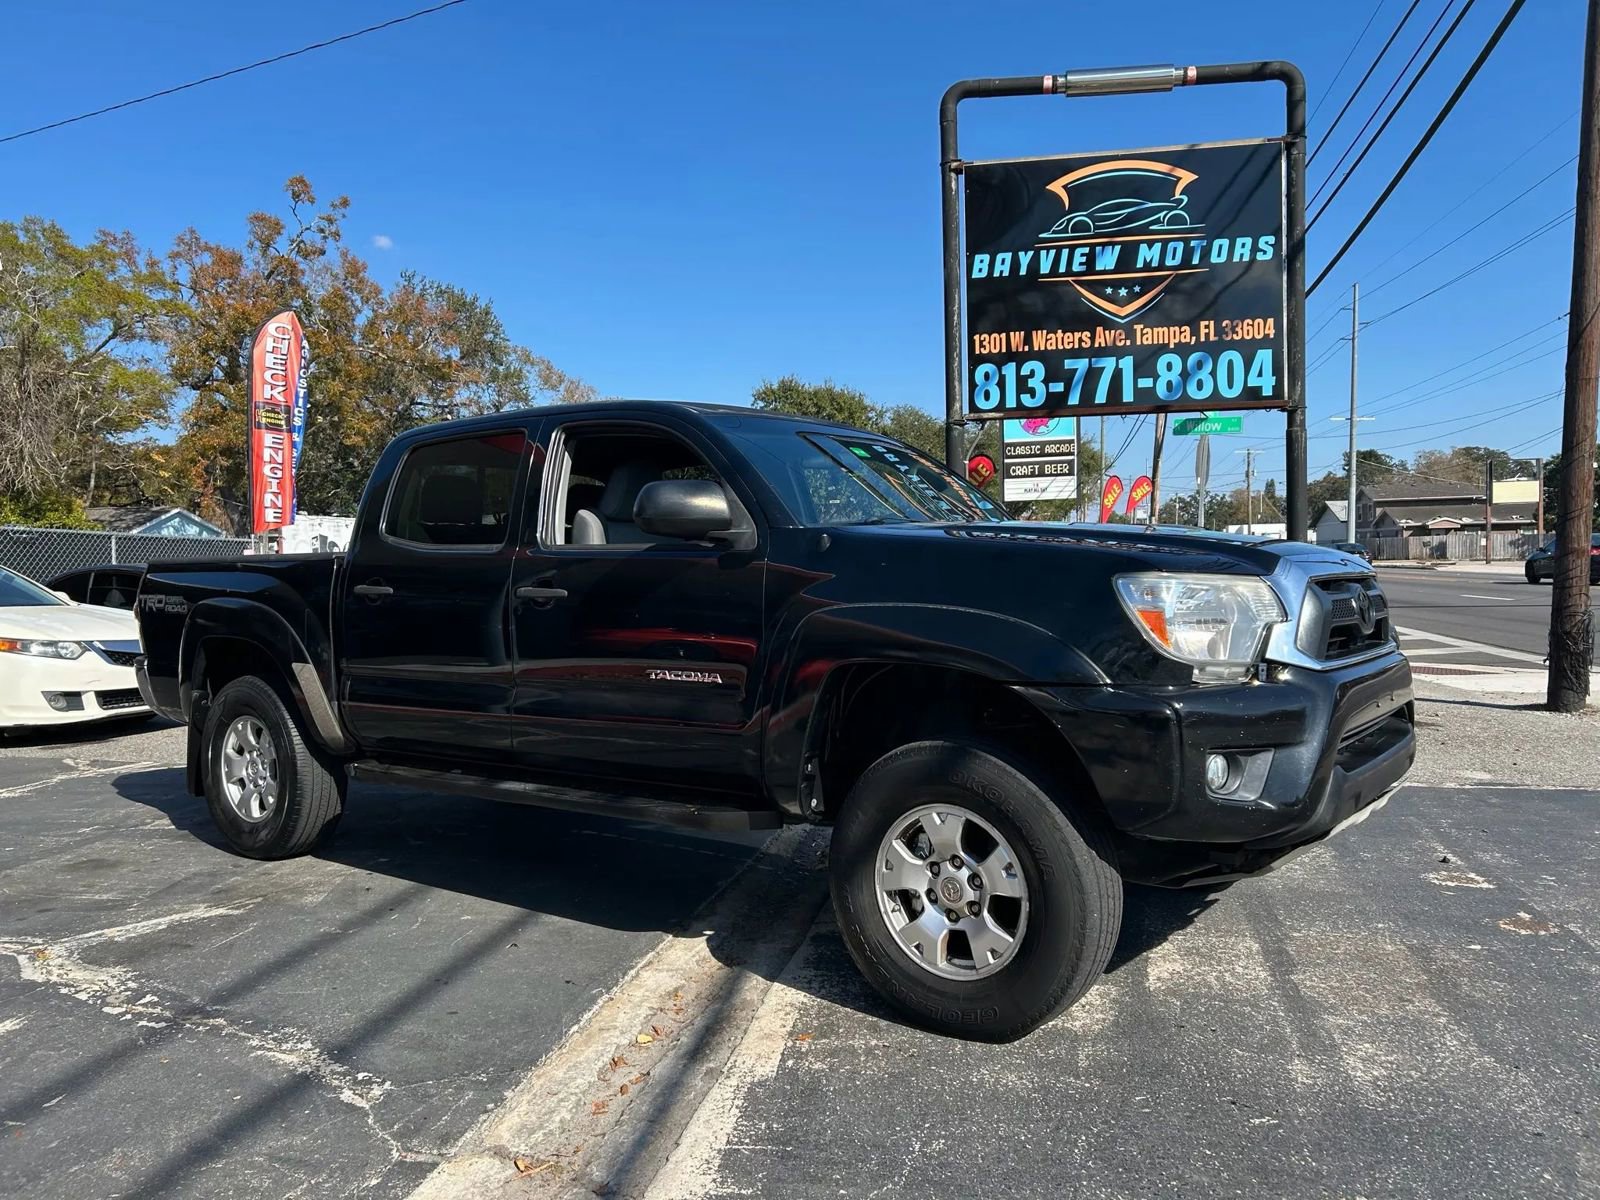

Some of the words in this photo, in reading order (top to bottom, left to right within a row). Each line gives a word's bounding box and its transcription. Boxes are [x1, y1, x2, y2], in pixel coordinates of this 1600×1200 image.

[971, 245, 1121, 279] BAYVIEW
[1136, 235, 1276, 269] MOTORS
[974, 333, 1006, 354] 1301
[1010, 331, 1028, 352] W.
[1032, 328, 1091, 351] Waters
[1094, 325, 1131, 347] Ave.
[1134, 322, 1196, 349] Tampa,
[1200, 320, 1218, 341] FL
[1222, 317, 1275, 341] 33604
[263, 322, 293, 401] CHECK
[973, 349, 1276, 410] 813-771-8804
[262, 411, 284, 419] CHECK
[1005, 445, 1041, 455] CLASSIC
[1044, 443, 1075, 453] ARCADE
[263, 432, 285, 523] ENGINE
[969, 463, 991, 486] LE
[1009, 465, 1040, 476] CRAFT
[1044, 463, 1069, 474] BEER
[1103, 484, 1121, 508] SALE
[1131, 482, 1151, 501] SALE
[645, 669, 723, 684] TACOMA
